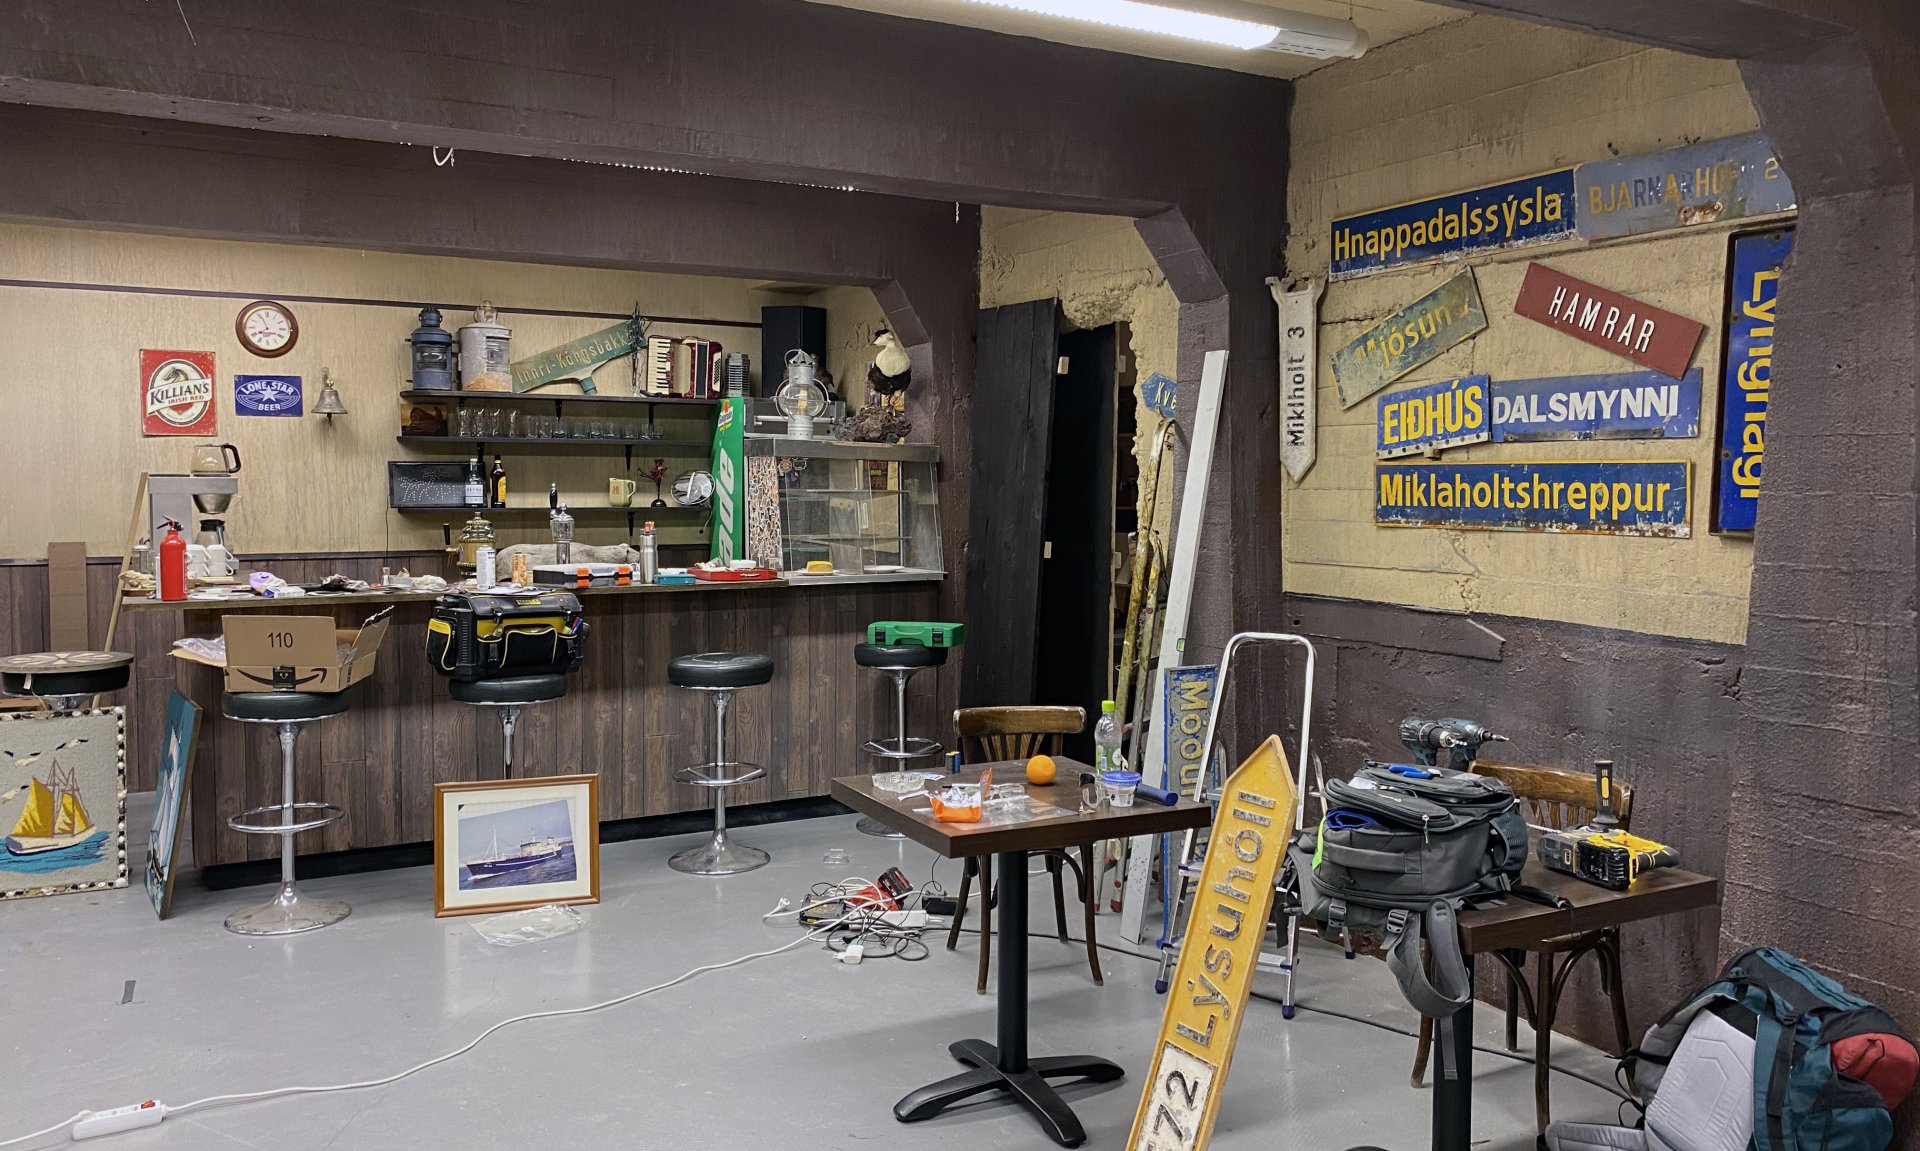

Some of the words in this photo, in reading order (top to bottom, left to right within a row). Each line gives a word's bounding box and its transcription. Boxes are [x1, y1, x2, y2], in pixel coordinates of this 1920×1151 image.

[1334, 186, 1563, 261] Hnappadalssýsla
[1287, 325, 1305, 339] 3
[1548, 286, 1656, 353] HAMRAR
[168, 396, 188, 405] IRISH
[240, 381, 267, 395] LONE
[271, 381, 295, 396] STAR
[257, 403, 281, 412] BEER
[1287, 354, 1305, 447] Miklholt
[1492, 384, 1681, 426] DALSMYNNI
[1380, 473, 1671, 521] Miklaholtshreppur
[267, 632, 294, 648] 110
[1175, 790, 1275, 1047] Lýsuhóll
[1147, 1070, 1200, 1151] 72
